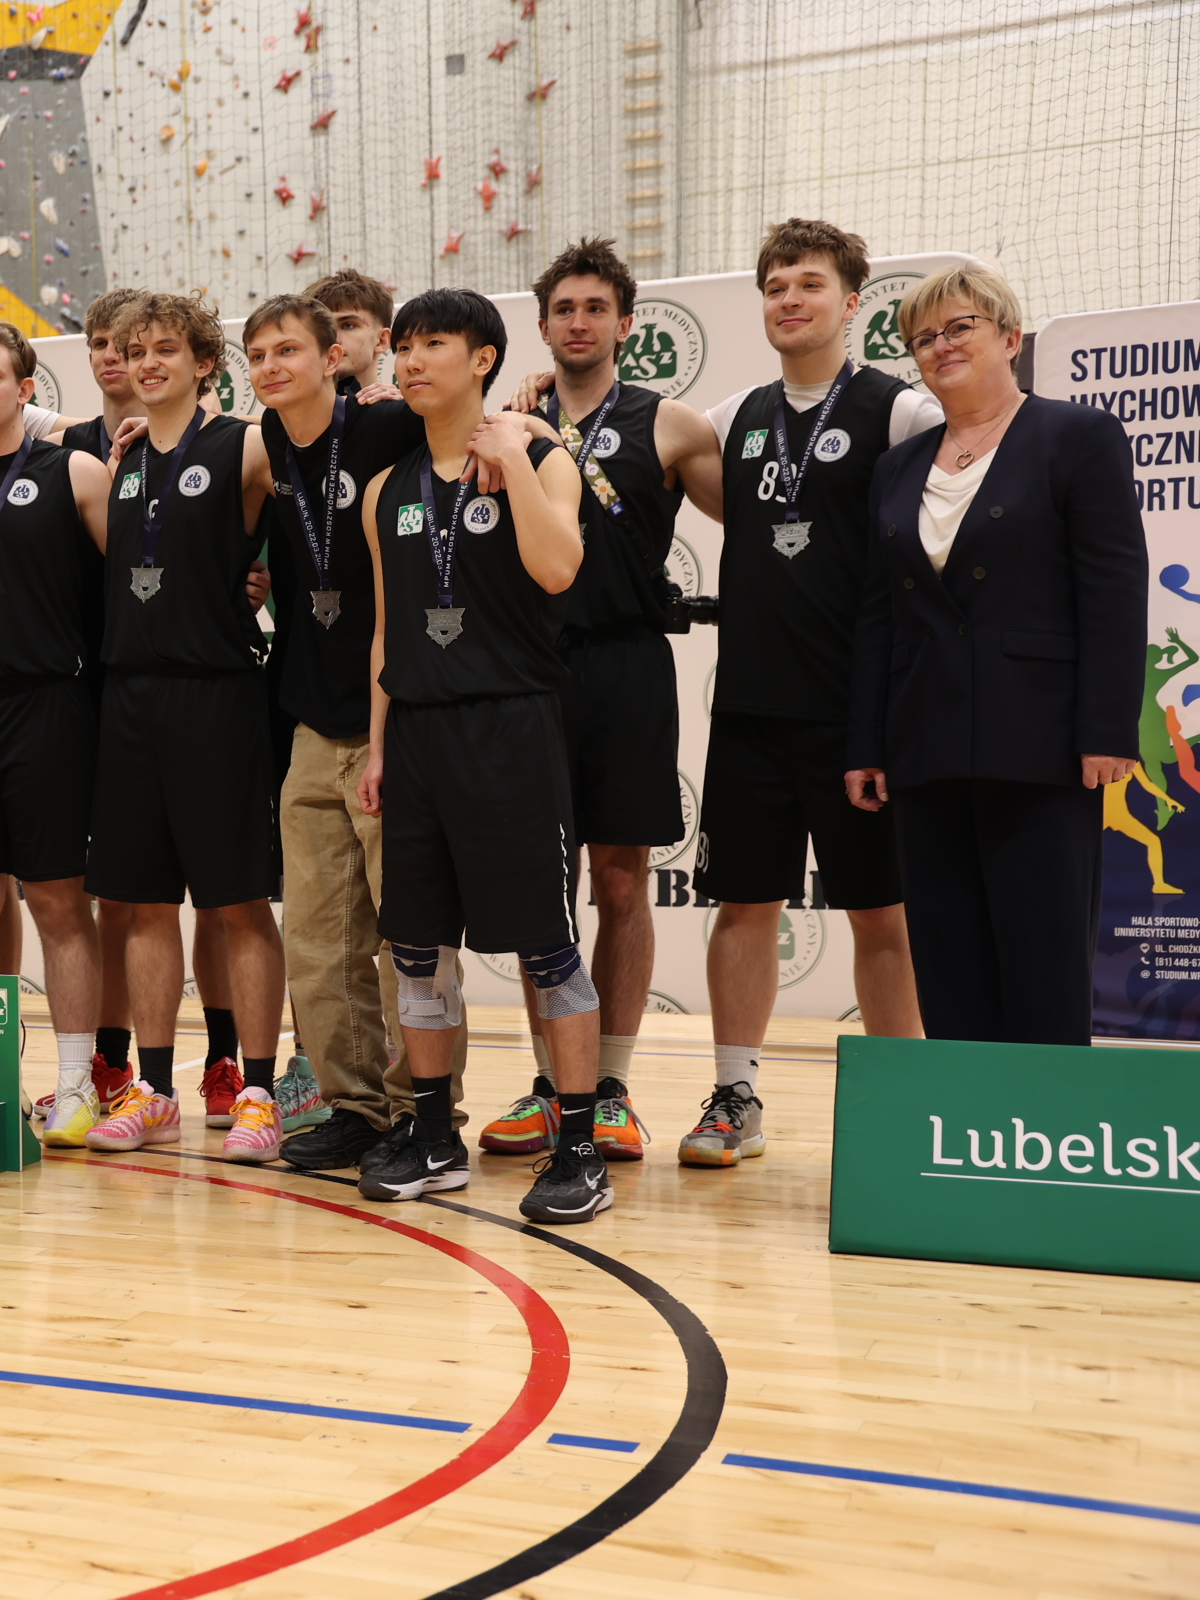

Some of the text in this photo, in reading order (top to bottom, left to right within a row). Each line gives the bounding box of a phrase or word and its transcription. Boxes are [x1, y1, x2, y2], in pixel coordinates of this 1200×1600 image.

[661, 308, 699, 364] MEDYCZNY
[448, 496, 463, 553] KOSZYKÓWCE
[1131, 916, 1153, 926] HALA
[1114, 927, 1176, 938] UNIWERSYTETU
[1154, 944, 1167, 953] UL.
[1155, 957, 1172, 967] (81)
